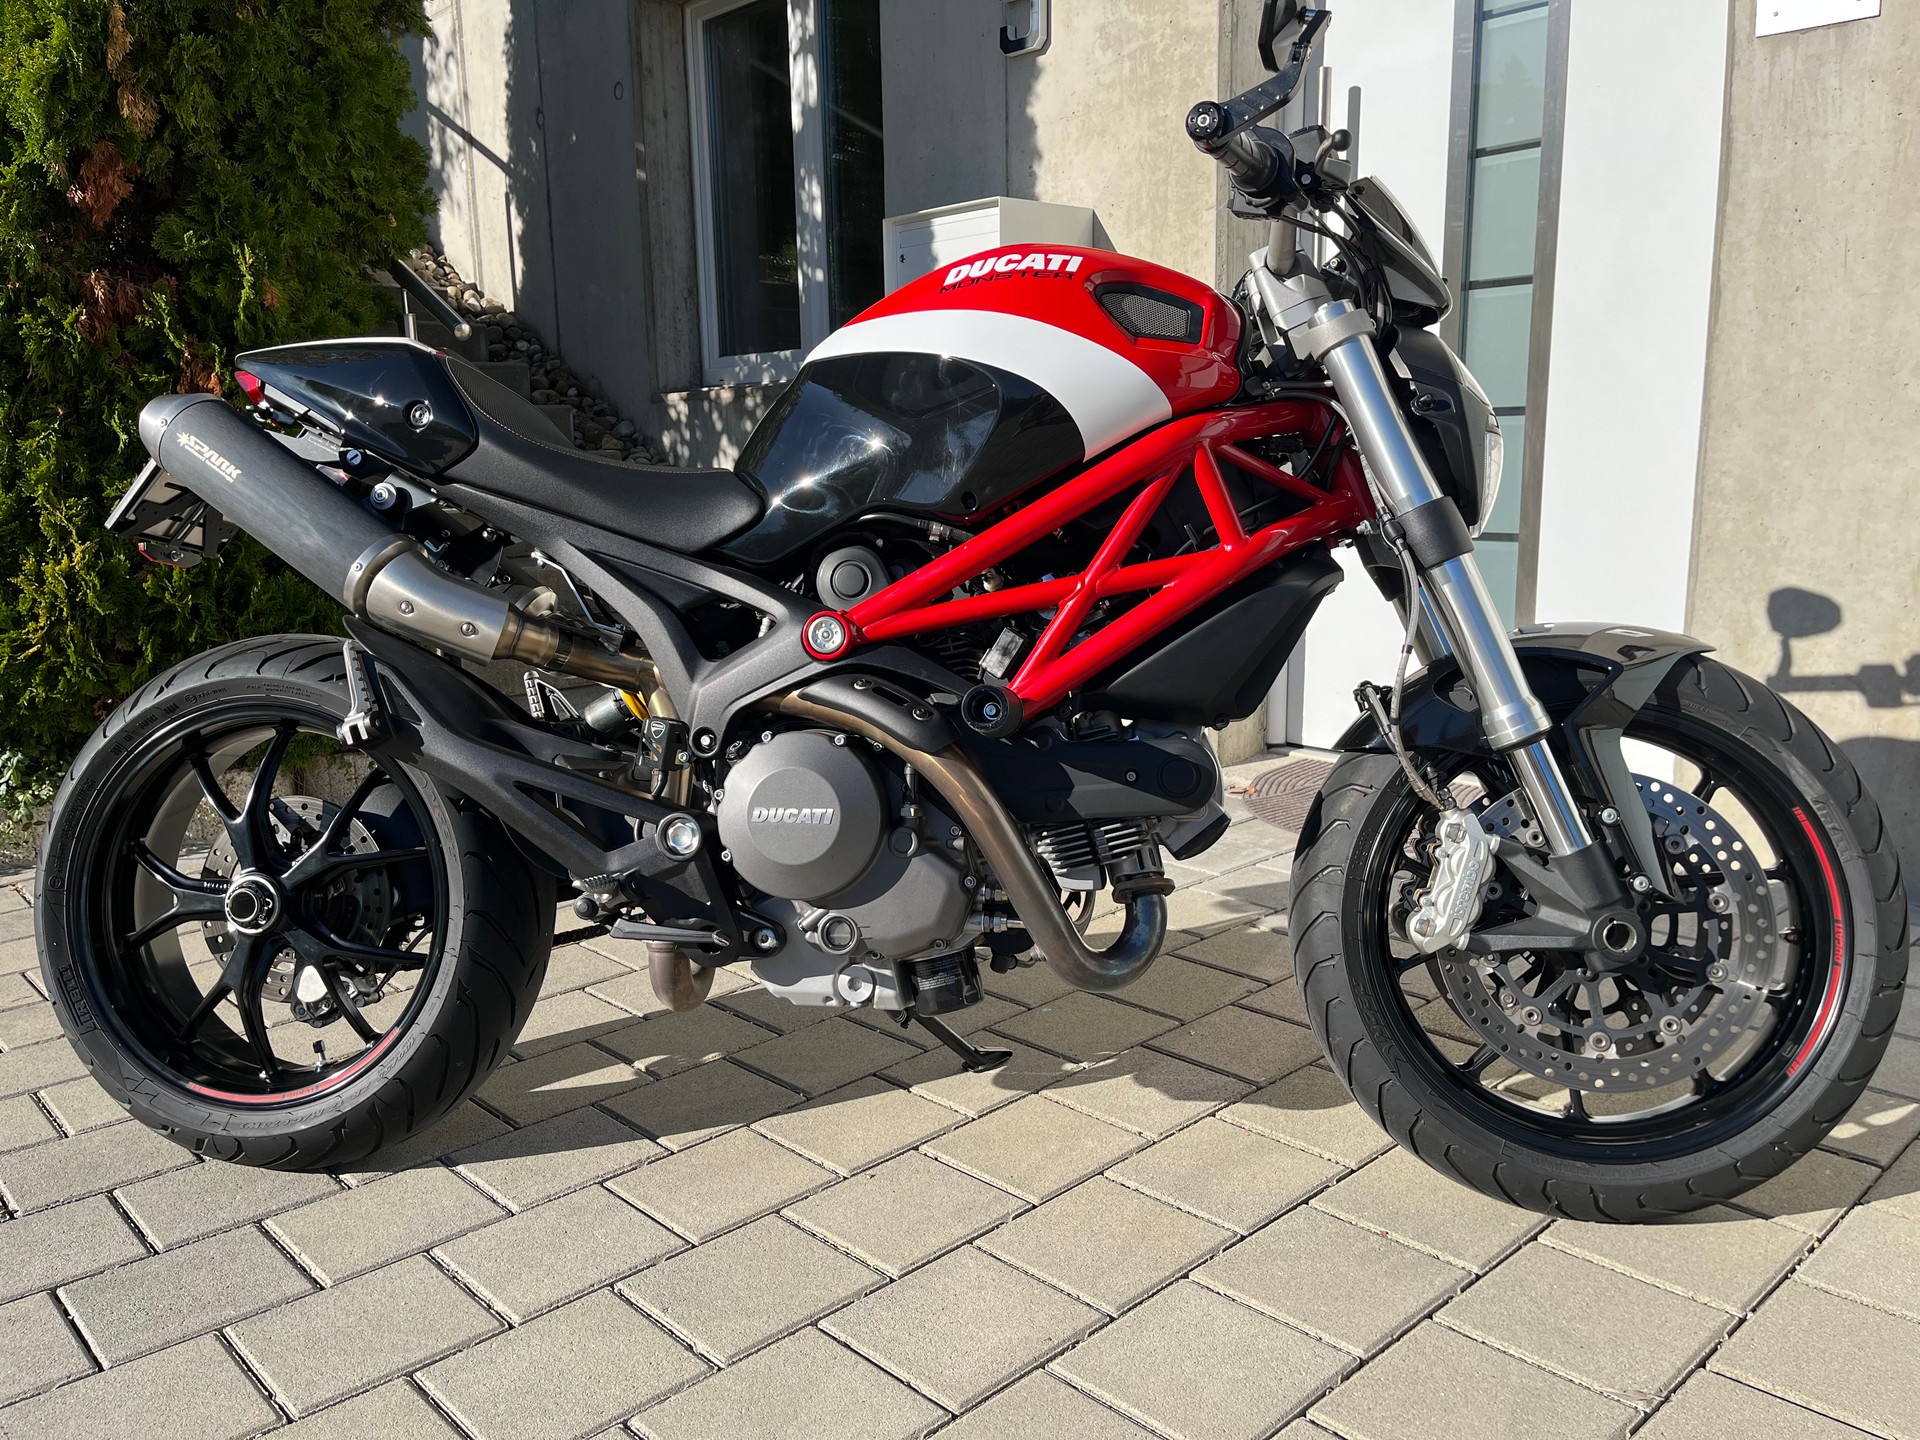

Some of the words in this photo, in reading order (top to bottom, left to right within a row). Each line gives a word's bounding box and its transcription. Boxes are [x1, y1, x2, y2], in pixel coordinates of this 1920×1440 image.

[940, 271, 1074, 293] MONSTER
[943, 253, 1084, 286] DUCATI
[187, 434, 242, 480] SPARK
[751, 807, 835, 825] DUCATI
[1451, 860, 1480, 918] brembo
[1834, 923, 1844, 963] DUCATI
[58, 963, 97, 1035] PIRELLI
